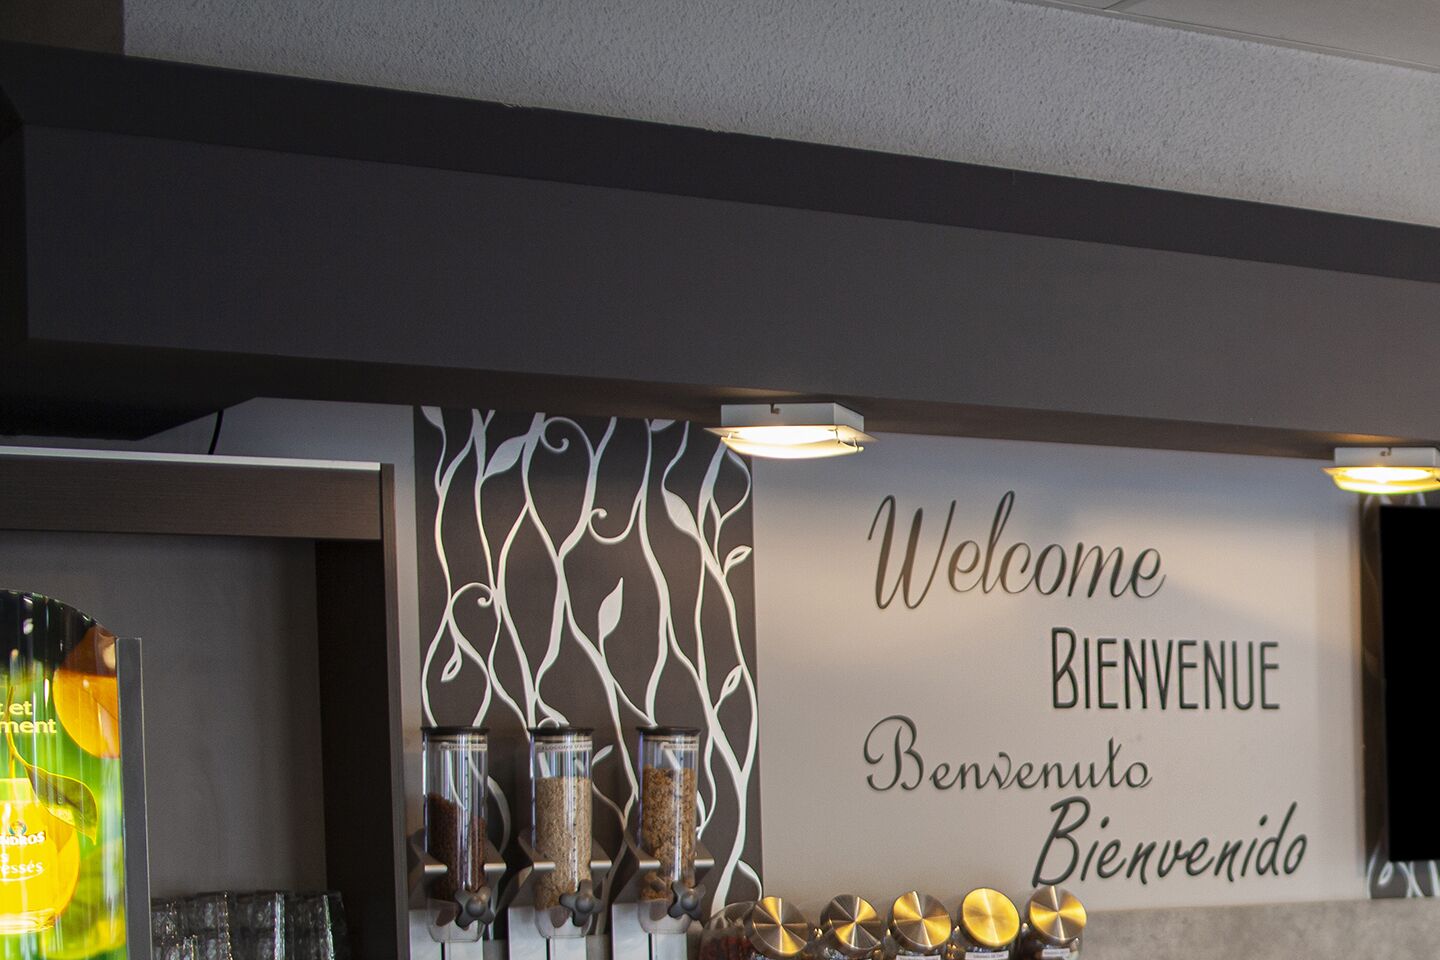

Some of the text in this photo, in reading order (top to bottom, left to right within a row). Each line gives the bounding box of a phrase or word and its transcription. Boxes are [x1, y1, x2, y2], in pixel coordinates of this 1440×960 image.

[867, 490, 1167, 610] Welcome
[8, 700, 33, 716] et
[863, 714, 1153, 791] Benvenuto
[1031, 796, 1308, 887] Bienvenido
